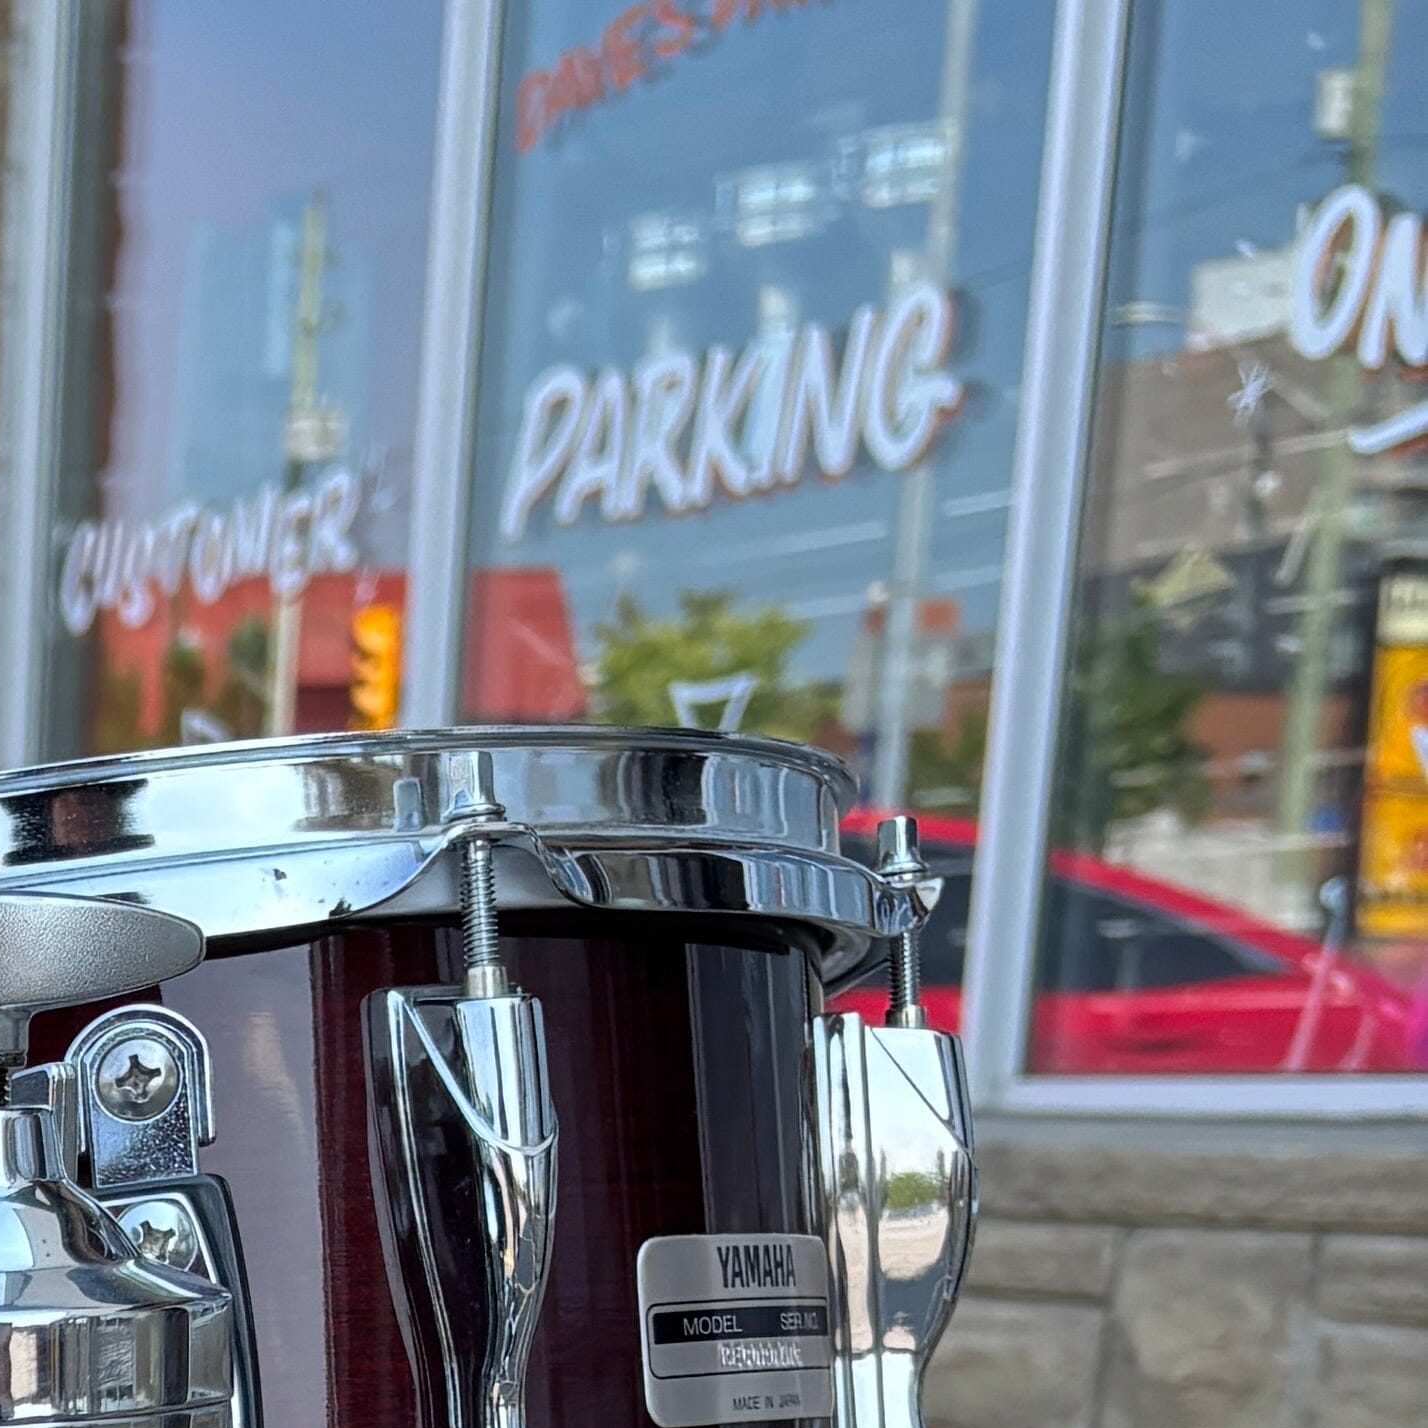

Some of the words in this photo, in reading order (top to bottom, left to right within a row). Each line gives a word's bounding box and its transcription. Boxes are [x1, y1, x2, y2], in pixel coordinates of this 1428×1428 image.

[60, 468, 358, 640] CUSTOMER
[499, 286, 962, 542] PARKING
[716, 1244, 797, 1289] YAMAHA
[683, 1315, 744, 1336] MODEL
